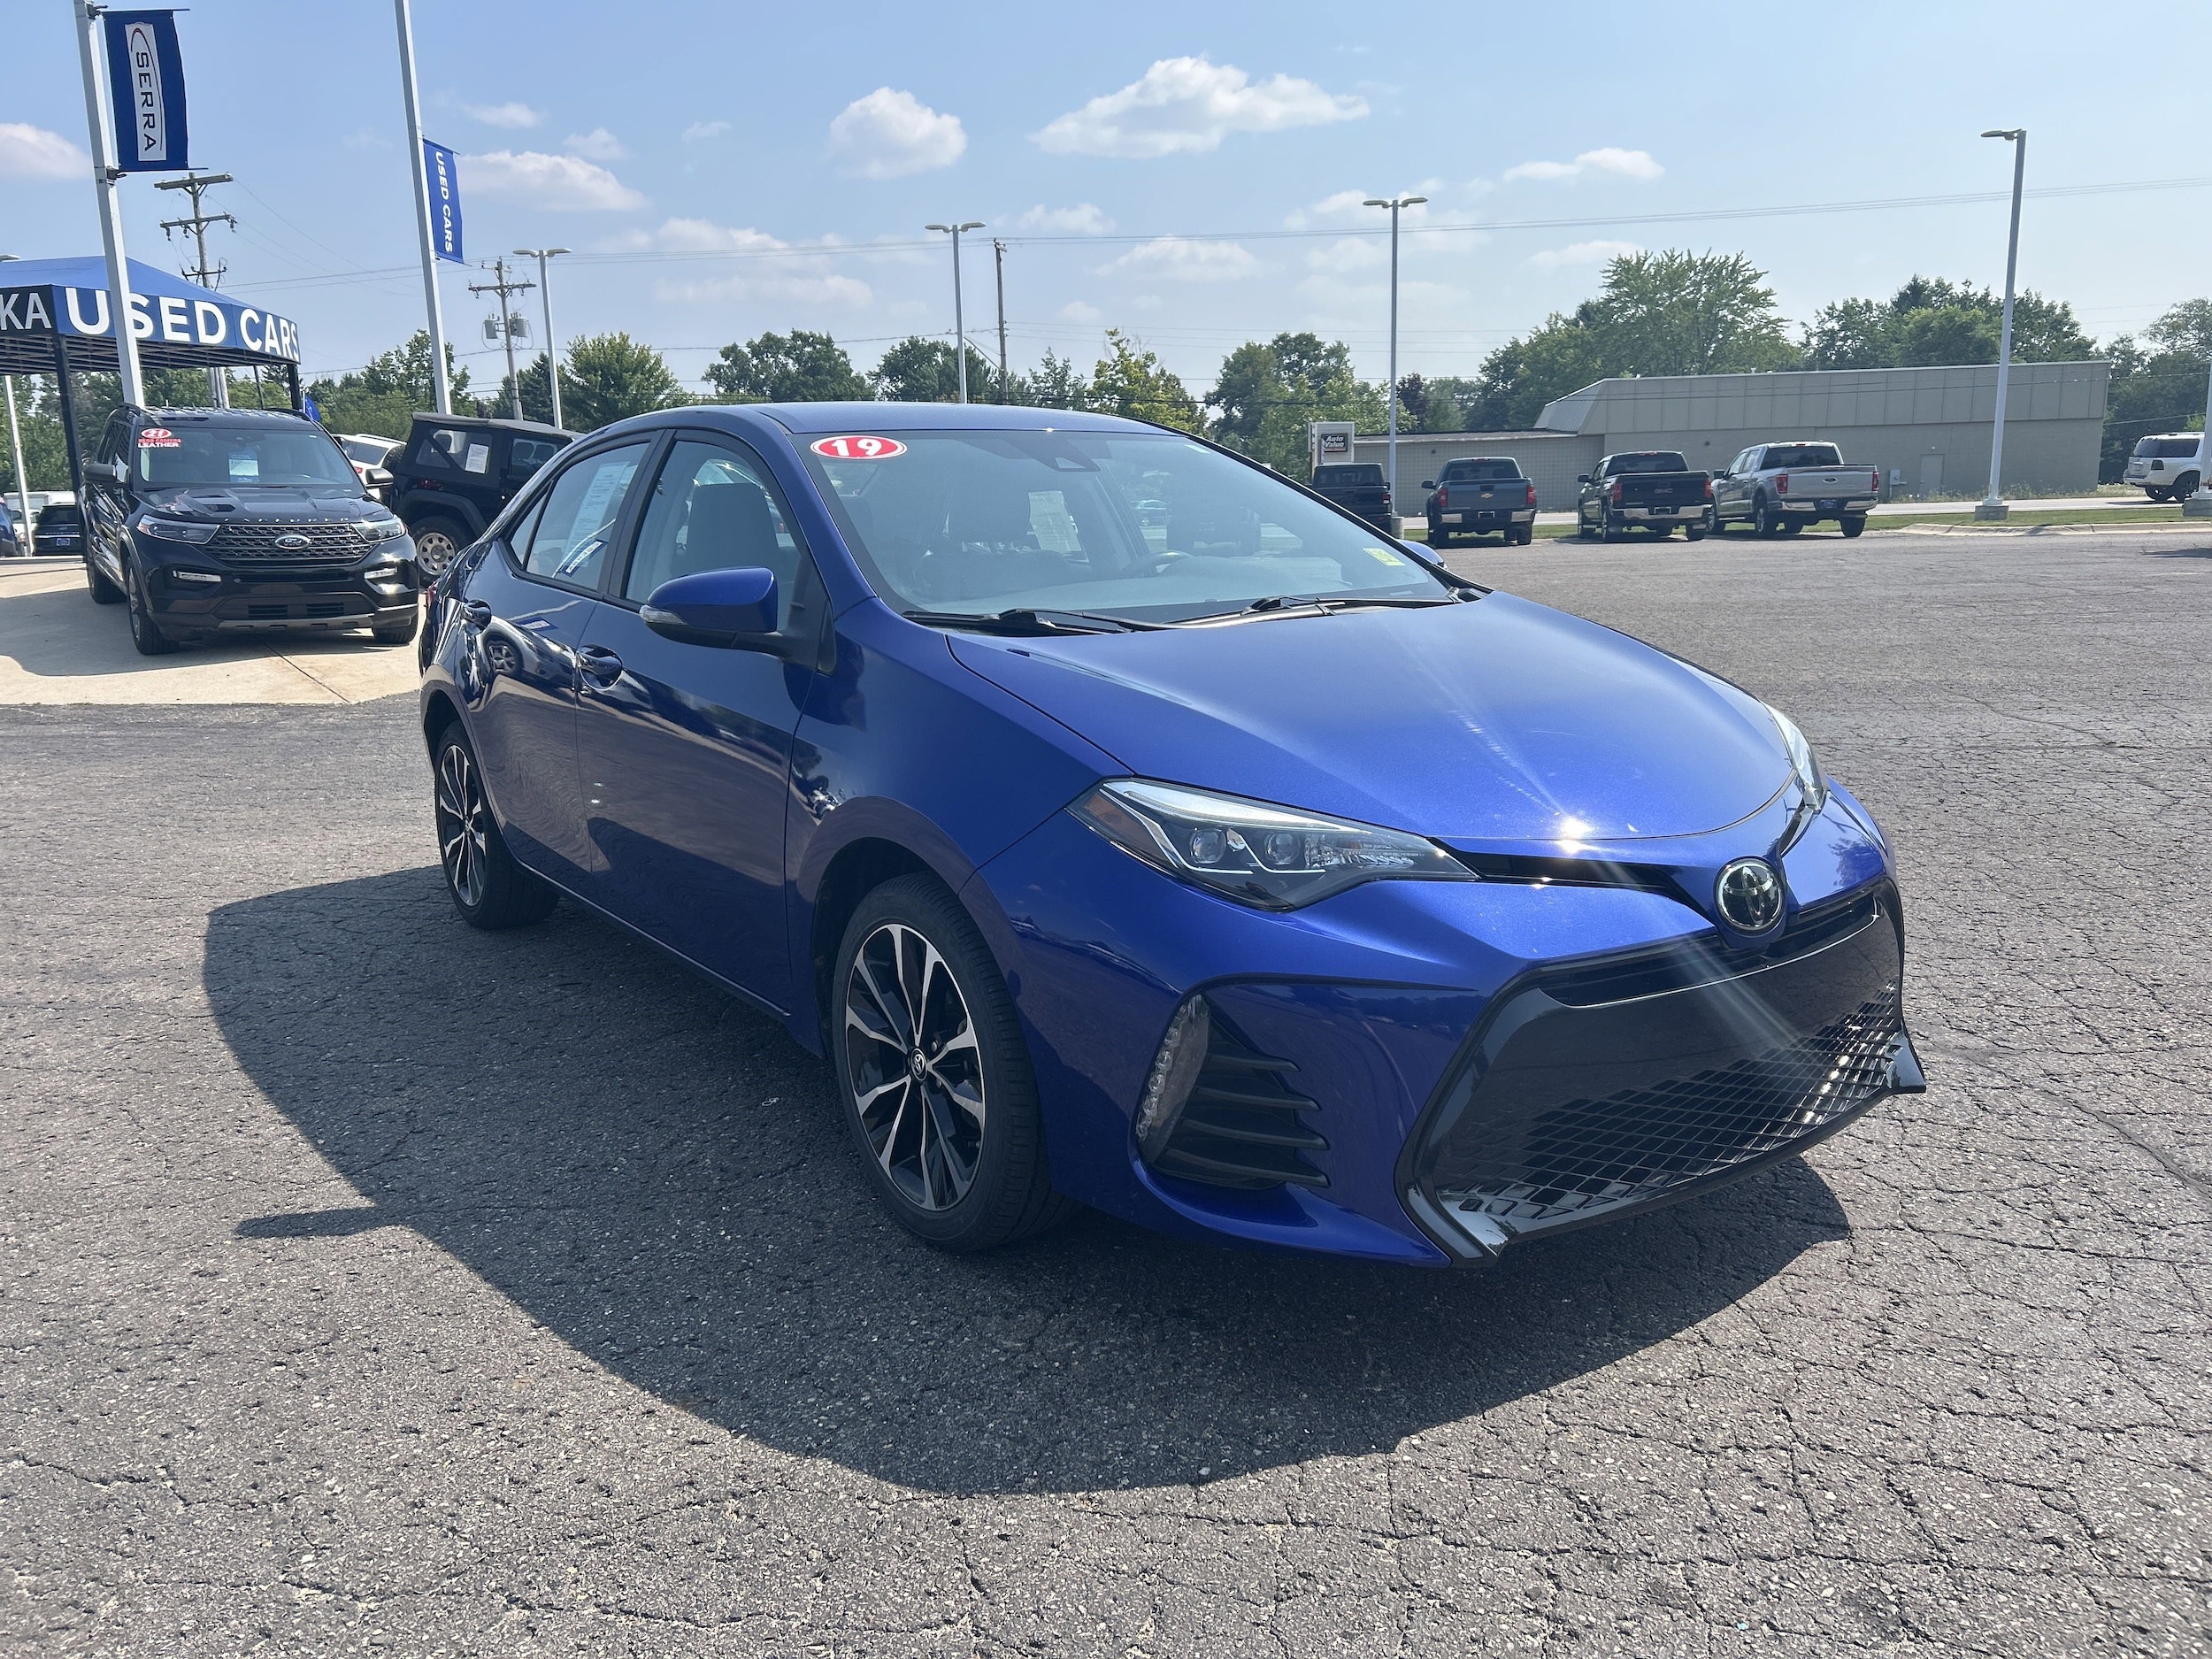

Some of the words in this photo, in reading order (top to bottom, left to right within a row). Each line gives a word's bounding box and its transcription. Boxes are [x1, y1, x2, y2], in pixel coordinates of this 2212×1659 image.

[136, 51, 157, 151] SERRA
[435, 151, 449, 200] USED
[443, 204, 453, 252] CARS
[0, 293, 52, 331] KA
[65, 288, 227, 344] USED
[240, 309, 301, 362] CARS
[831, 438, 882, 457] 19
